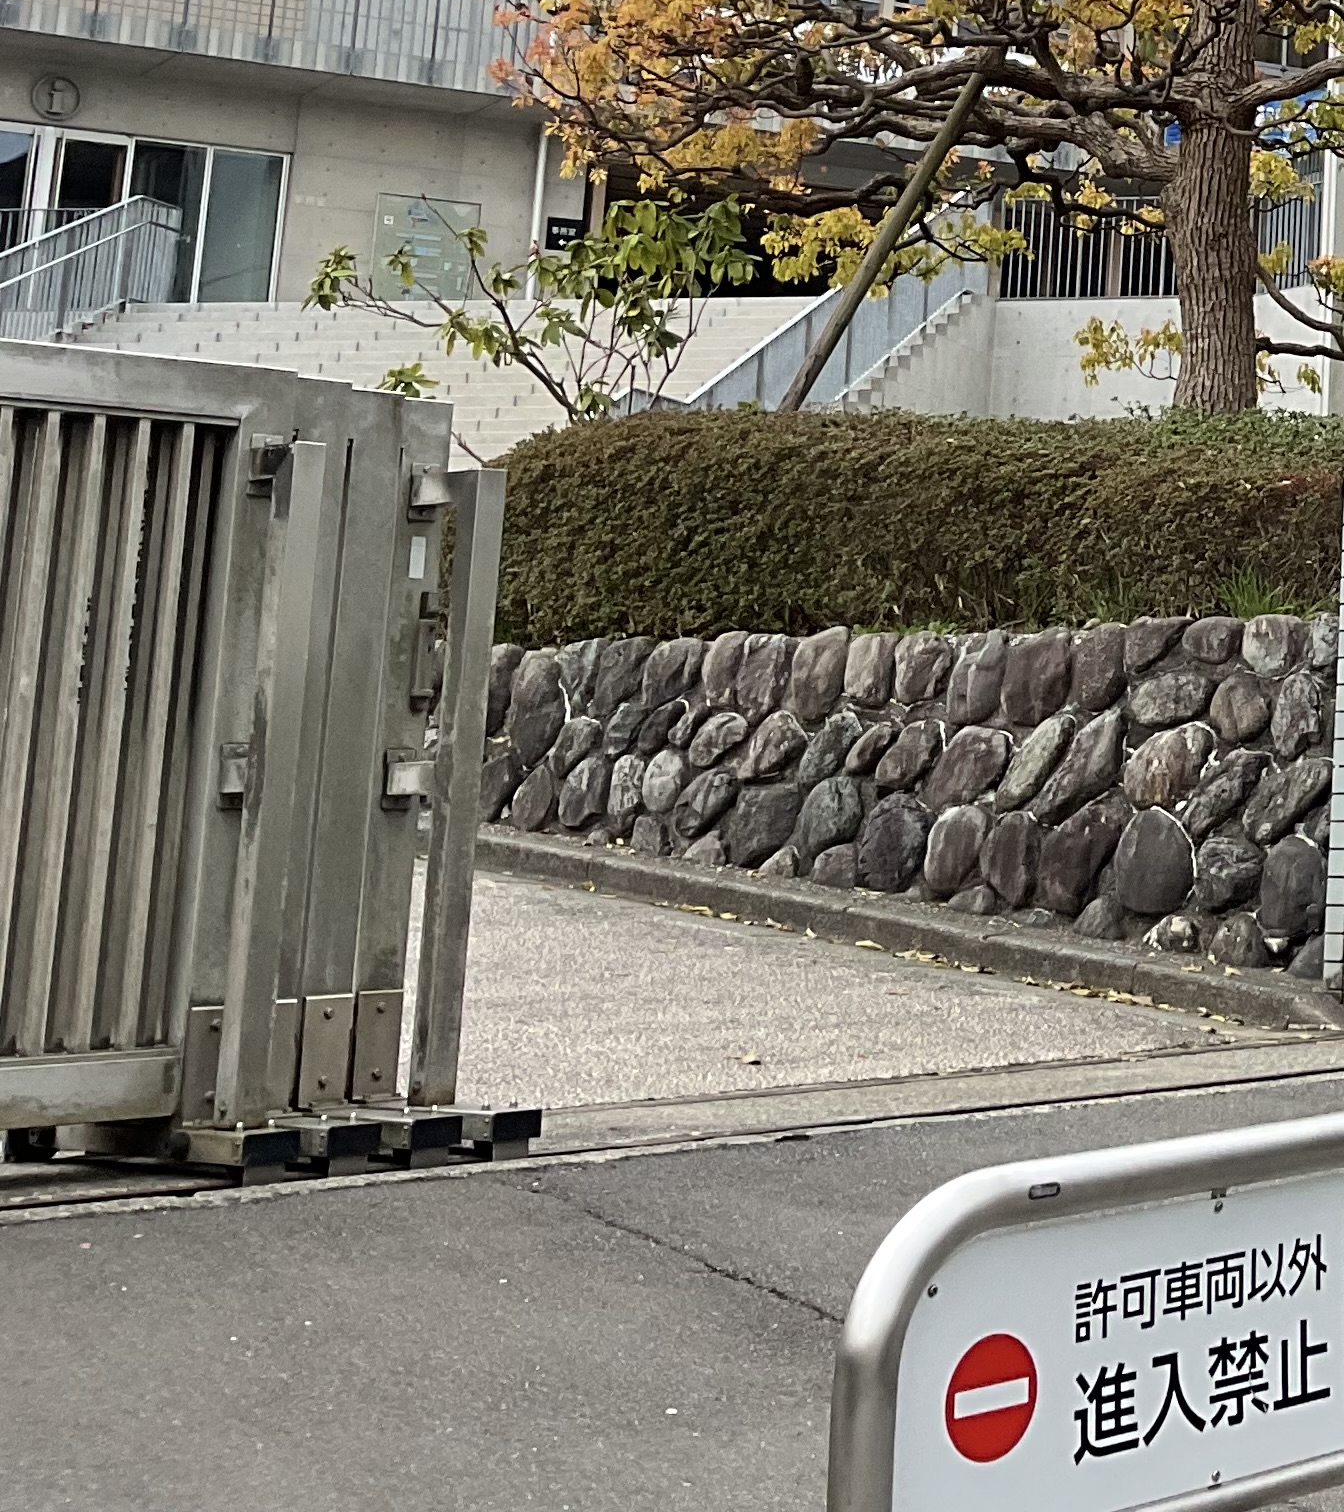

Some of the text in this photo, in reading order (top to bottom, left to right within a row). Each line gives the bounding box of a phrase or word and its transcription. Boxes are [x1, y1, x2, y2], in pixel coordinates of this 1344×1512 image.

[1074, 1233, 1328, 1343] 許可車両以外
[1073, 1319, 1332, 1466] 進入禁止
